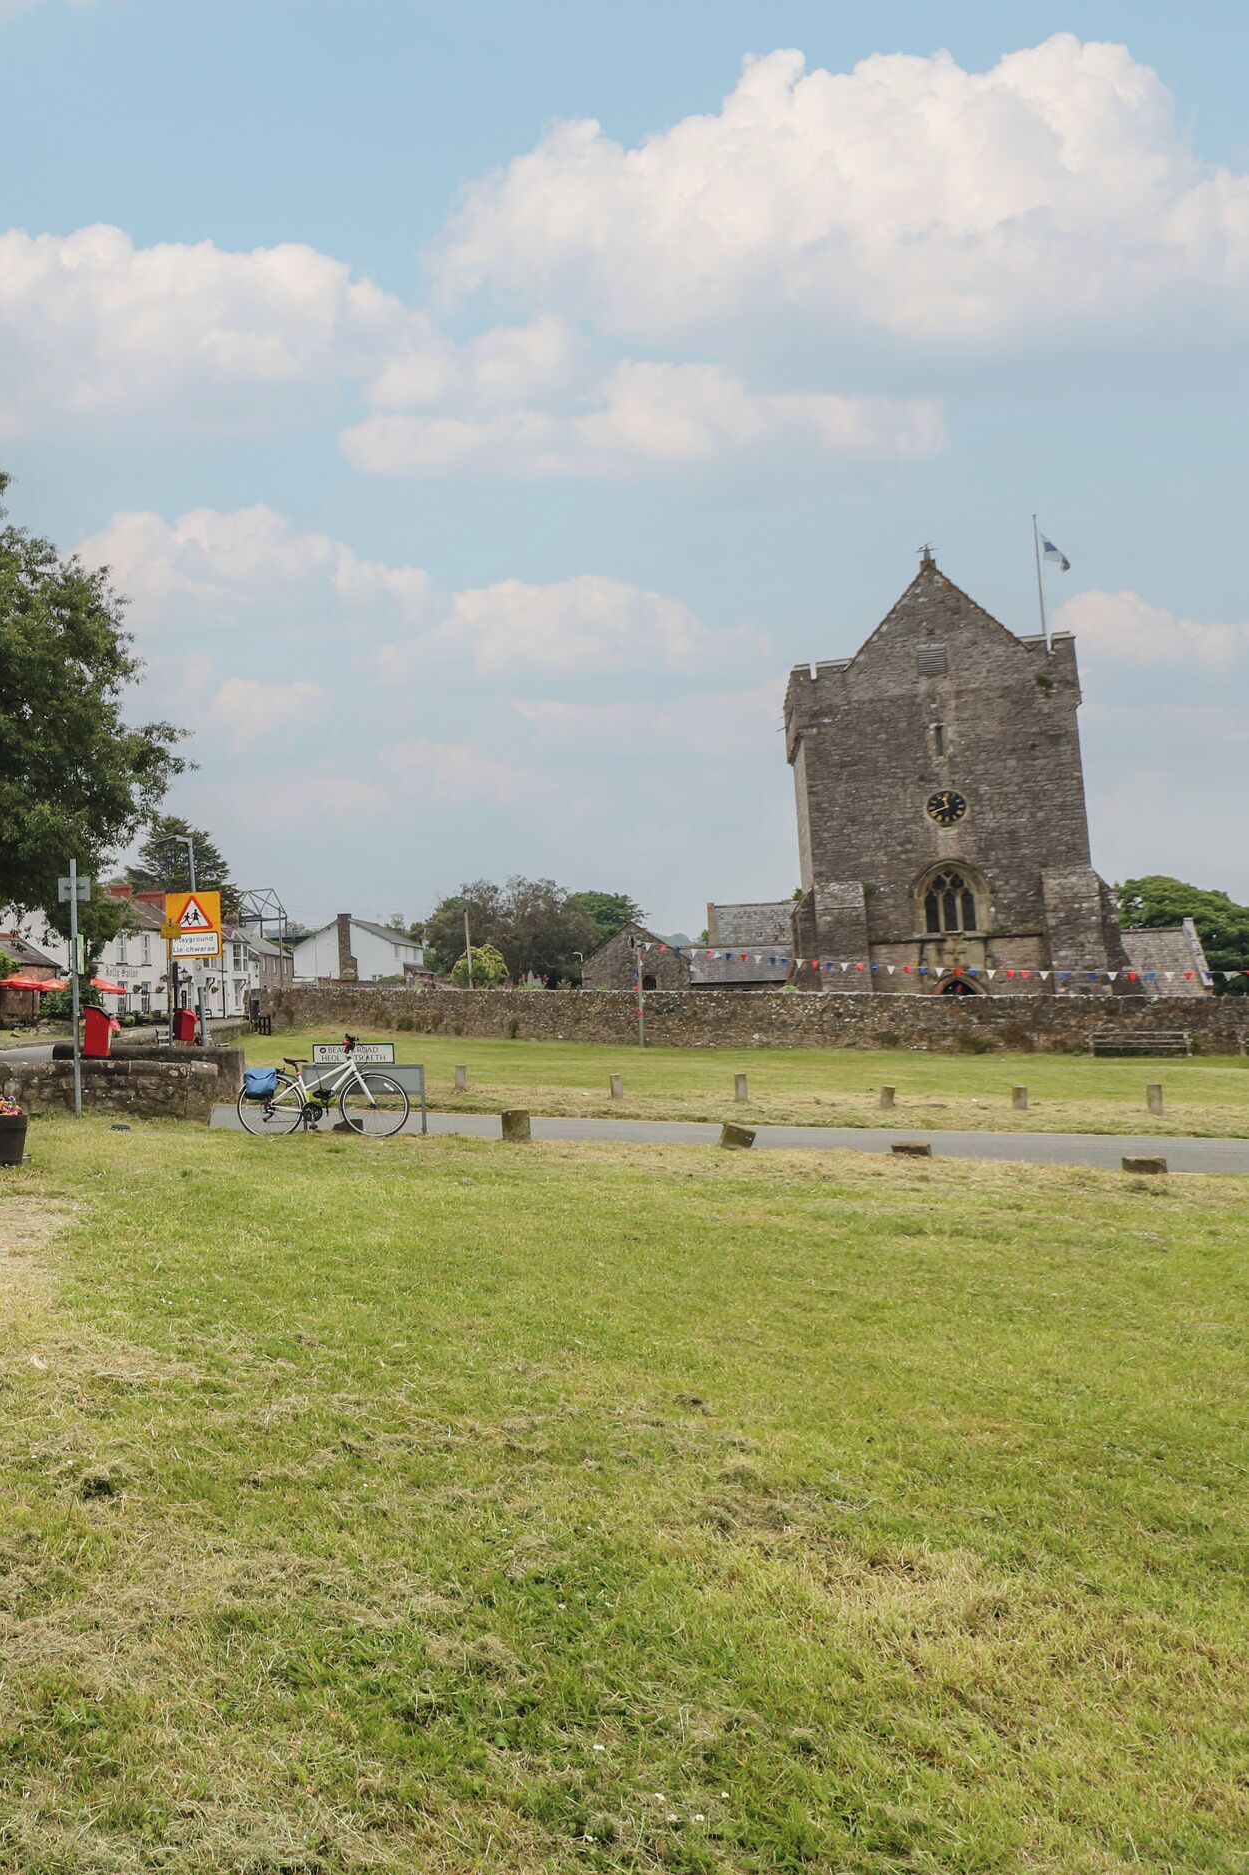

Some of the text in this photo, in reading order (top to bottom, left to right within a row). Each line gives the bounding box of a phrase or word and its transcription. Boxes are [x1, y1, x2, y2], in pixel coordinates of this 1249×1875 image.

[174, 935, 214, 944] Playground
[185, 945, 216, 953] chwarae
[105, 964, 138, 978] Jolly Sailor
[356, 1046, 379, 1054] ROAD
[321, 1054, 340, 1062] HEOL
